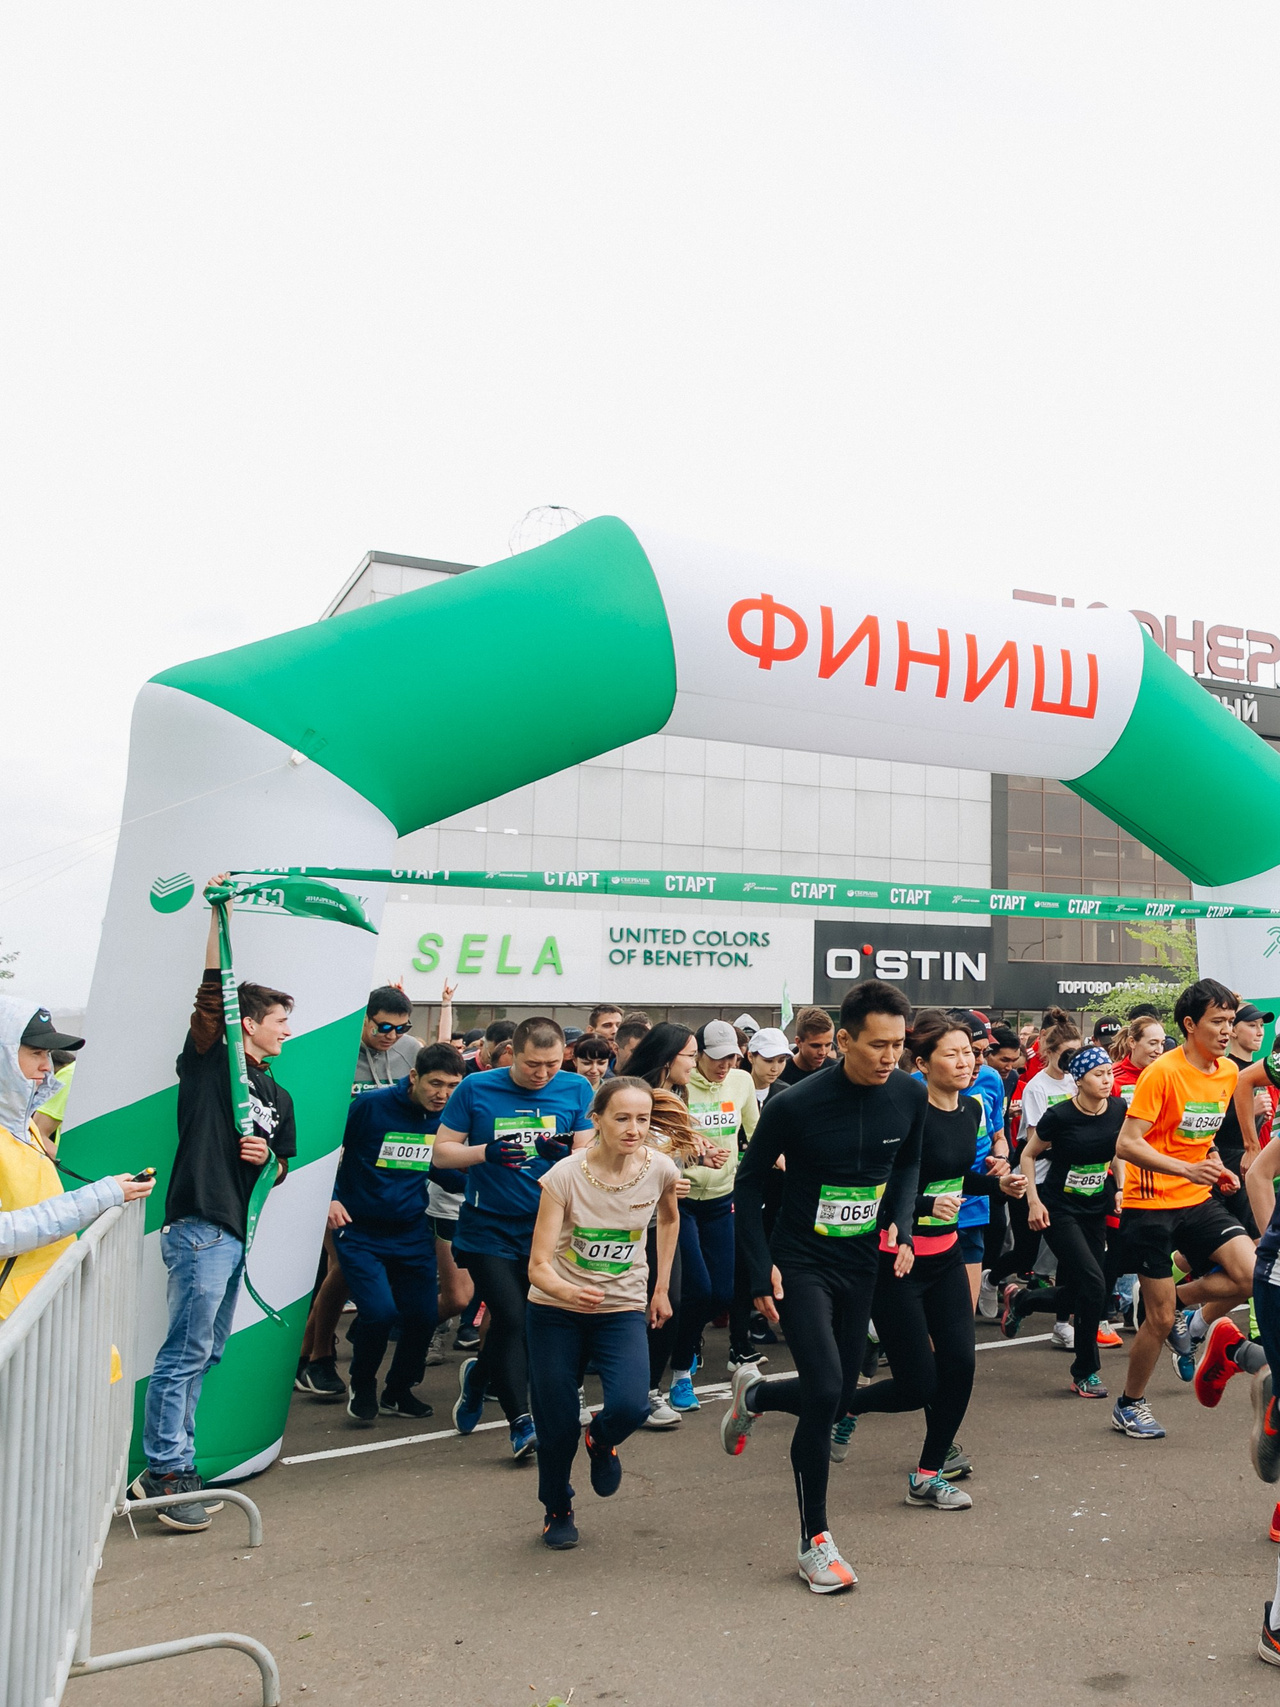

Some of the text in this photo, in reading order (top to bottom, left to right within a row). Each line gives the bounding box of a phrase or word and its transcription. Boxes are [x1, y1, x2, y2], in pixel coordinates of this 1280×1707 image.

[727, 592, 1100, 720] ФИНИШ
[1211, 692, 1259, 723] ЫЙ
[543, 871, 600, 887] СТАРТ
[664, 874, 717, 893] СТАРТ
[790, 881, 837, 900] СТАРТ
[890, 888, 932, 905] СТАРТ
[990, 894, 1027, 911] СТАРТ
[1067, 899, 1102, 915] СТАРТ
[1144, 903, 1176, 917] СТАРТ
[1206, 905, 1235, 918] СТАРТ
[609, 926, 771, 948] UNITED COLORS
[412, 932, 564, 976] SELA
[608, 948, 637, 966] OF
[1099, 1023, 1122, 1033] FILA
[704, 1113, 735, 1126] 0582
[1195, 1116, 1223, 1128] 0340
[397, 1145, 430, 1159] 0017
[588, 1244, 635, 1260] 0127
